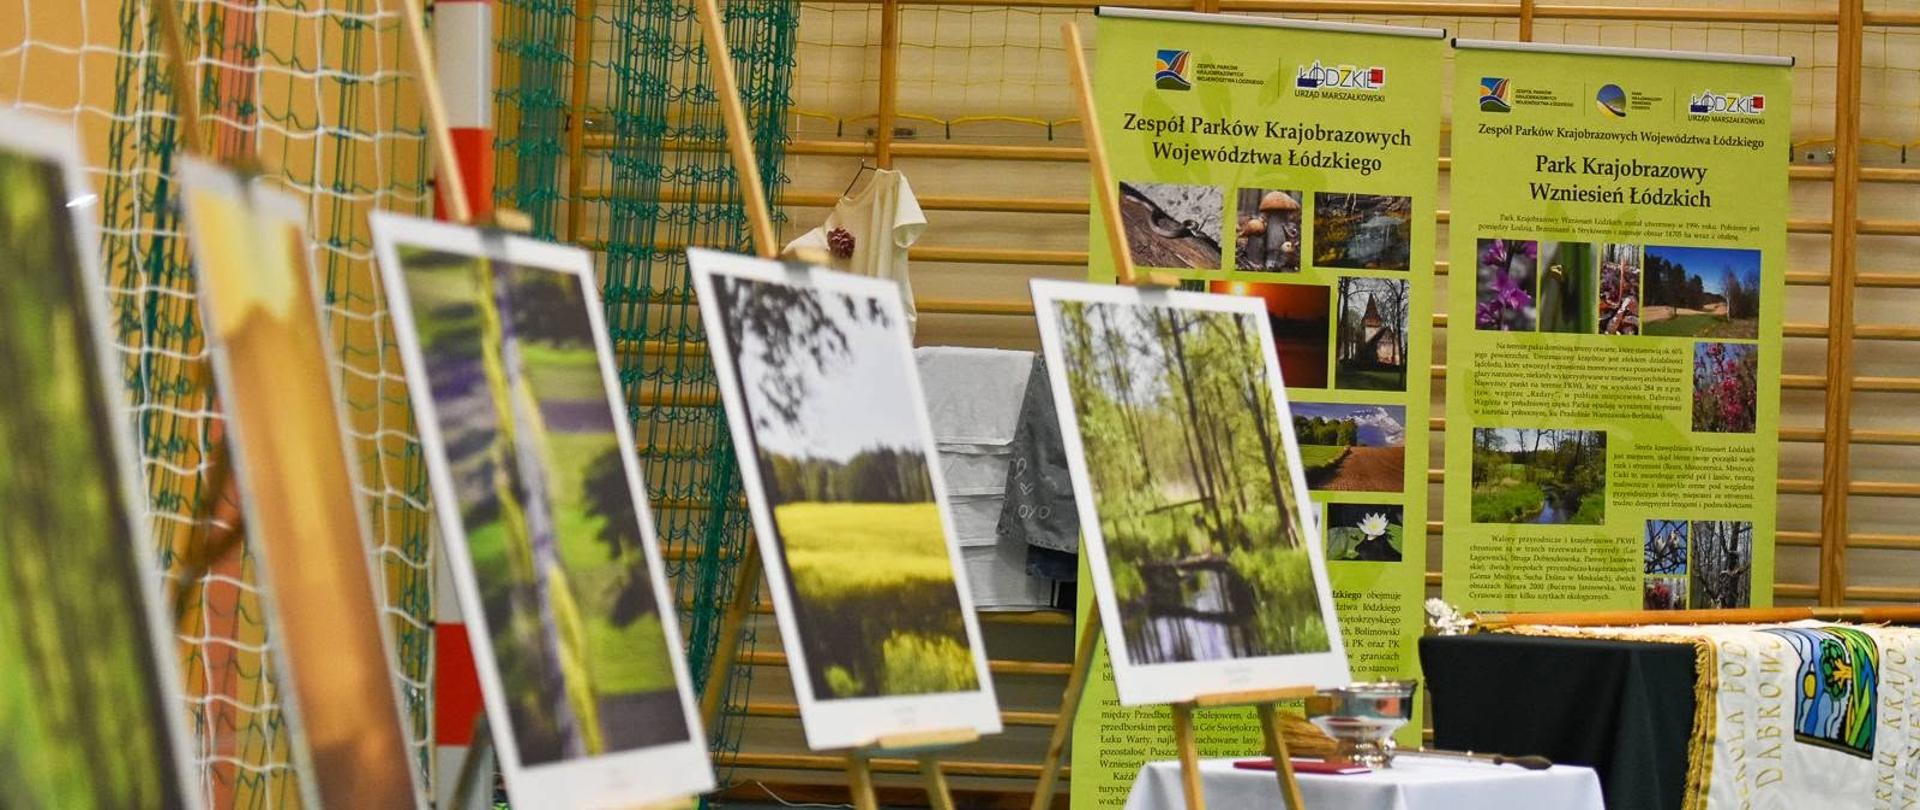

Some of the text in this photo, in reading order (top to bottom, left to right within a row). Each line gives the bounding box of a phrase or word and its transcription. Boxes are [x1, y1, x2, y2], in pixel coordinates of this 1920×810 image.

[1295, 90, 1386, 102] URZĄD MARSZAŁKOWSKI
[1124, 113, 1412, 150] Zespół Parków Krajobrazowych
[1478, 124, 1764, 149] Zespół Parków Krajobrazowych Województwa Łódzkiego
[1152, 142, 1382, 176] Województwa Łódzkiego
[1536, 155, 1708, 185] Park Krajobrazowy
[1530, 182, 1711, 208] Wzniesień Łódzkich
[1102, 710, 1130, 719] między
[1101, 723, 1156, 732] przedborskim
